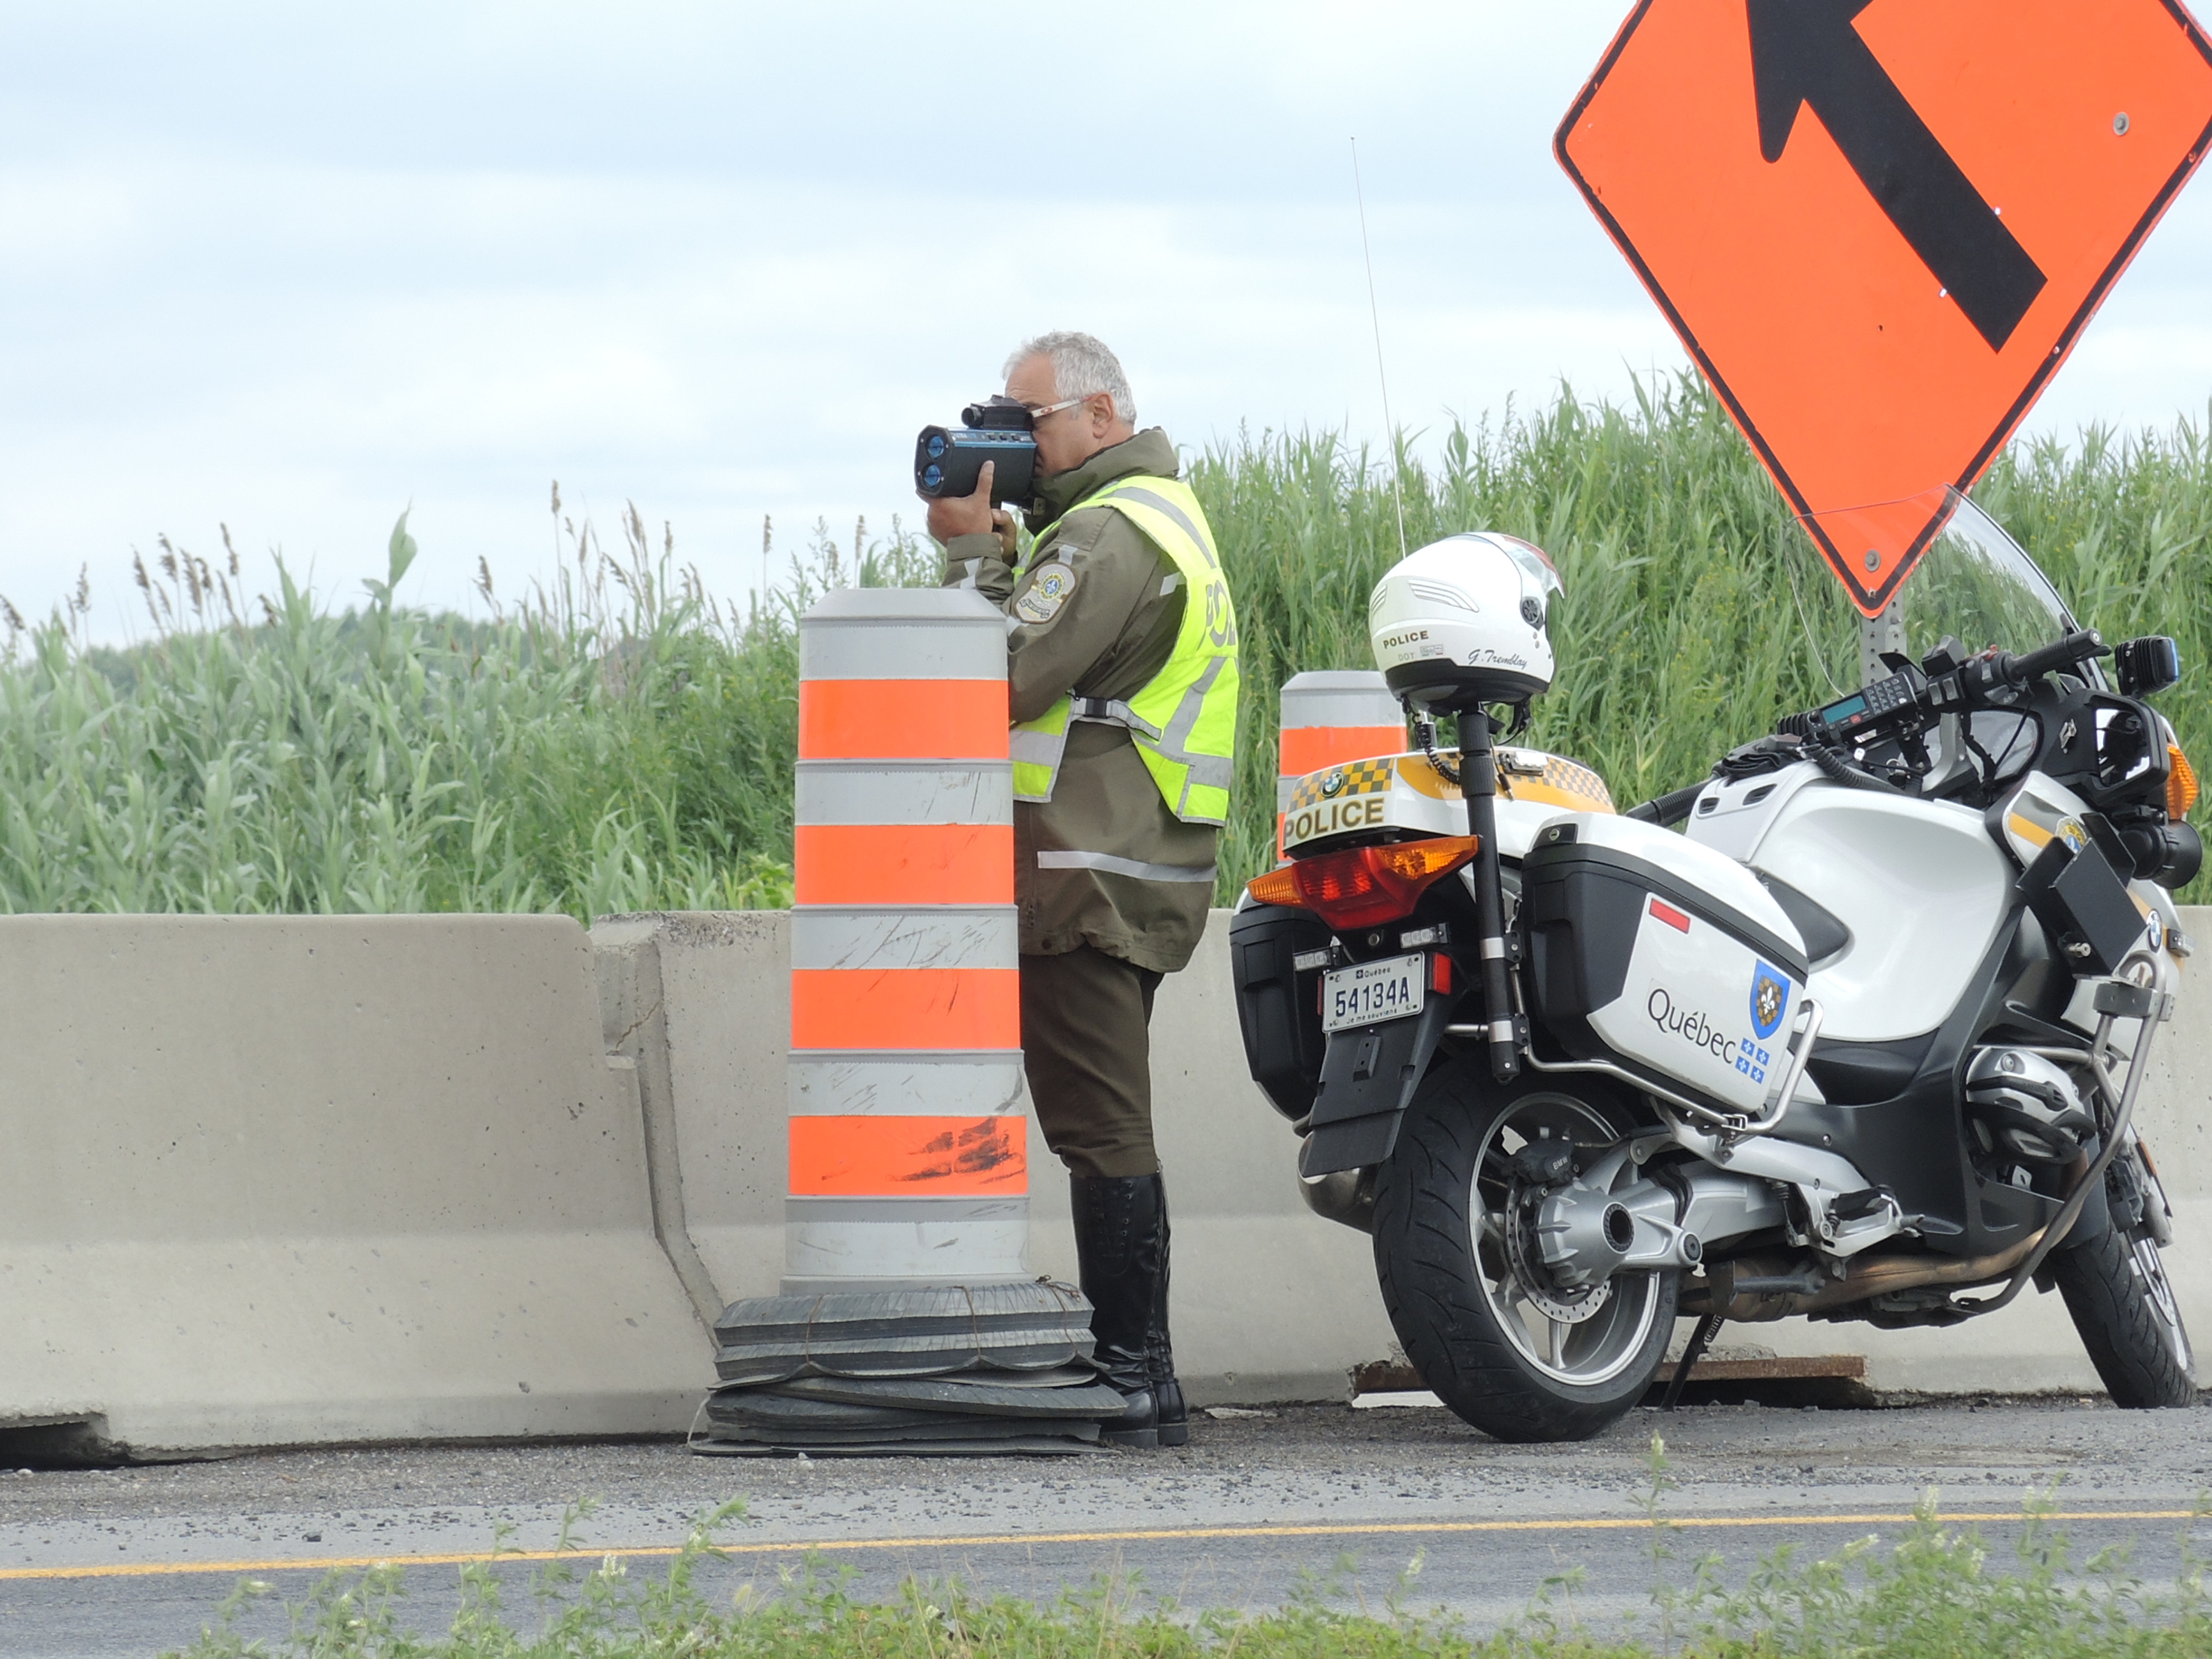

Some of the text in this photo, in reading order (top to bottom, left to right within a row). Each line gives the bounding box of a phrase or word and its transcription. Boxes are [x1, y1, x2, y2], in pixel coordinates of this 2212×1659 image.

[1383, 630, 1429, 649] POLICE
[1398, 653, 1415, 661] DOT
[1283, 797, 1385, 847] POLICE
[1364, 967, 1391, 978] Québec
[1335, 977, 1410, 1018] 54134A
[1647, 988, 1736, 1064] Québec
[1553, 1155, 1568, 1170] BMW
